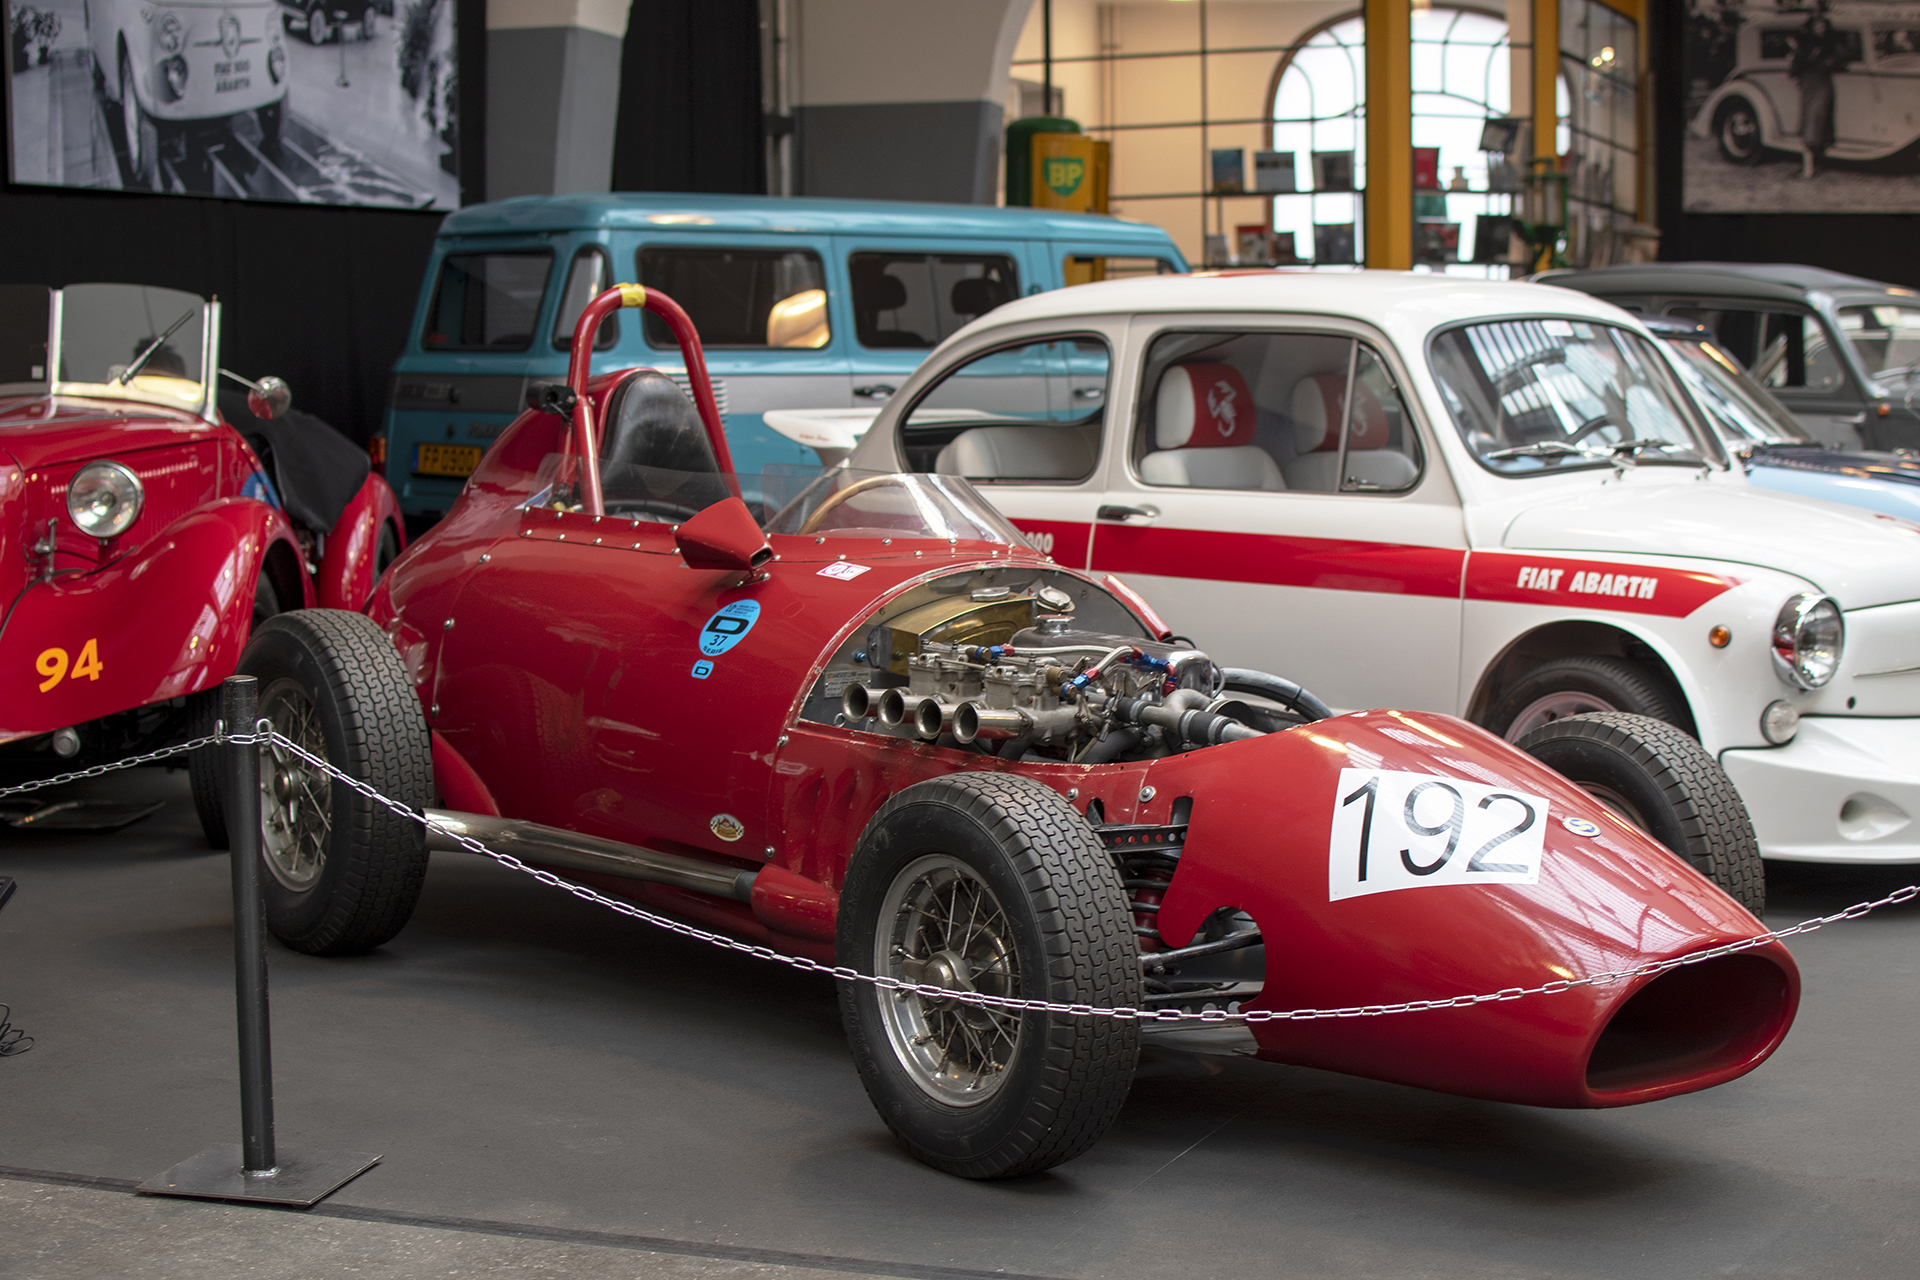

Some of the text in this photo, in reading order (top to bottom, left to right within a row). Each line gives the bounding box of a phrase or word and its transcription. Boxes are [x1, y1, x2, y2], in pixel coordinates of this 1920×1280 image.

[1049, 163, 1082, 187] BP
[1516, 566, 1658, 600] FIAT ABARTH
[705, 615, 750, 636] D
[709, 634, 729, 647] 37
[35, 637, 104, 694] 94
[694, 665, 710, 677] D
[1342, 776, 1536, 883] 192
